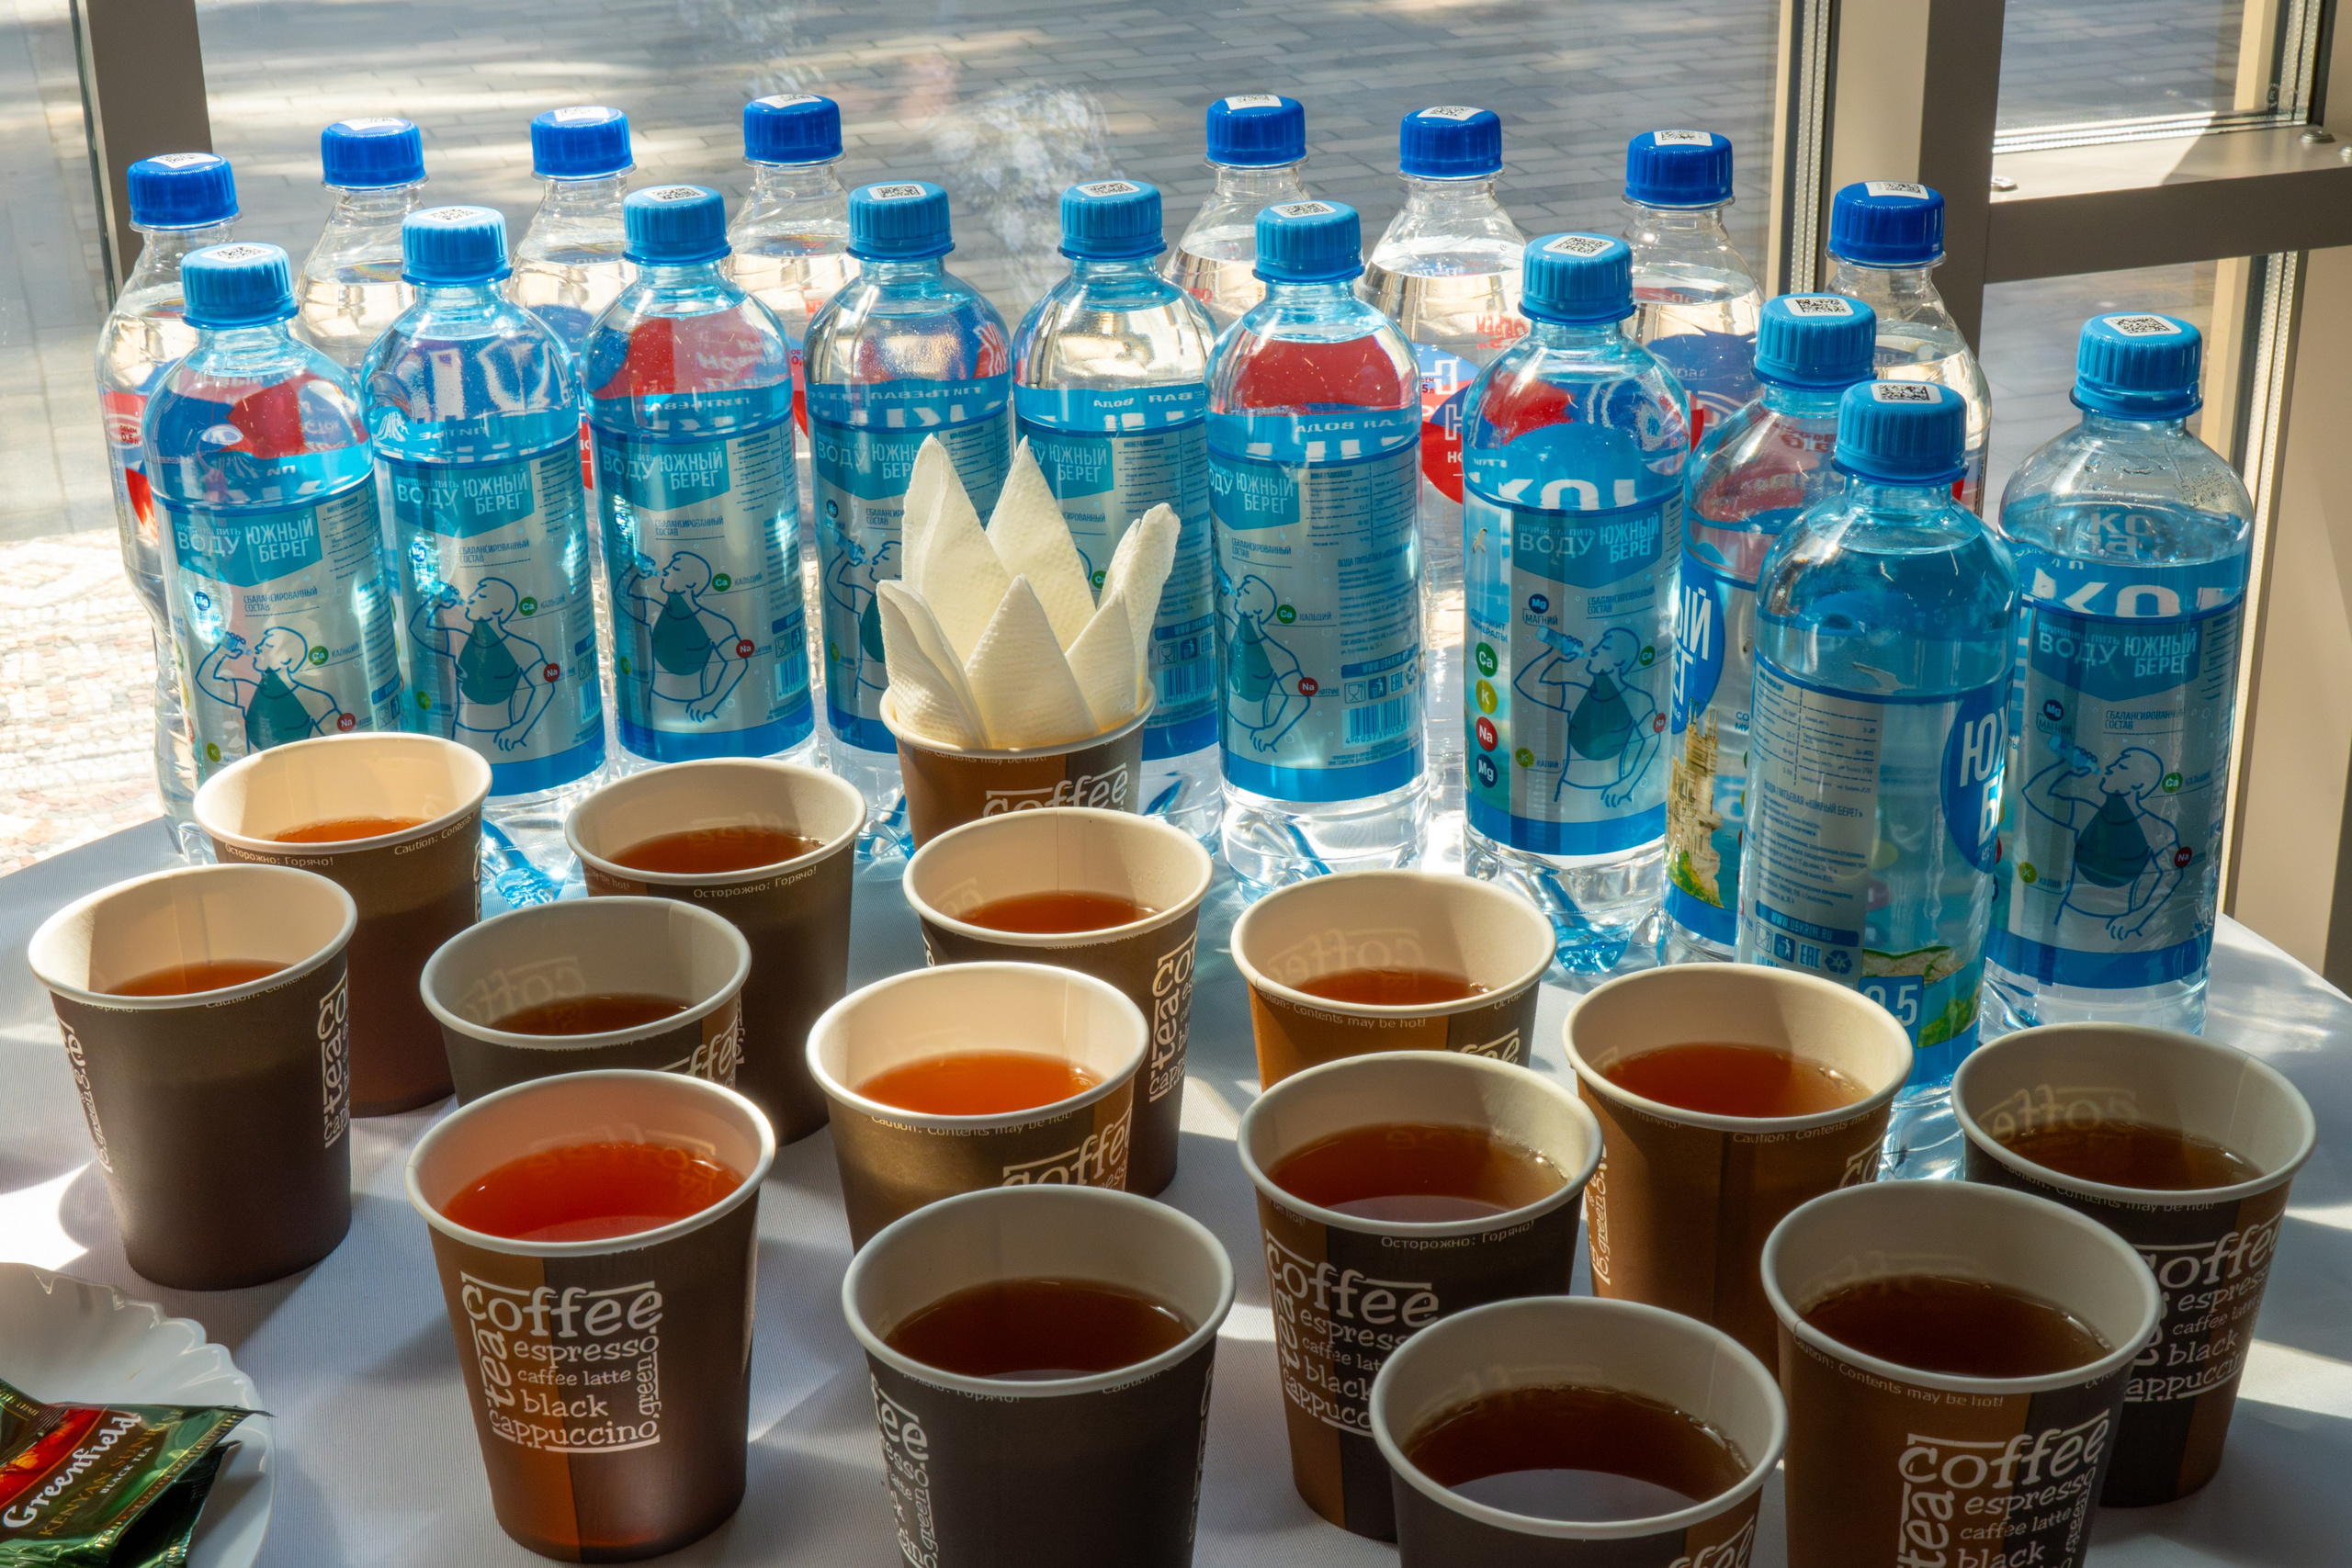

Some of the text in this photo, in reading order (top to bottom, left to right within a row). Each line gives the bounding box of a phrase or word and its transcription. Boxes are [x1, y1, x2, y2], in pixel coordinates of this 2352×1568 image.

[659, 447, 723, 472] ЮЖНЫЙ
[816, 442, 868, 468] ВОДУ
[872, 443, 919, 461] ЮЖН
[1048, 444, 1107, 466] ЮЖНЫЙ
[602, 452, 656, 480] ВОДУ
[882, 462, 911, 479] БЕР
[1057, 463, 1102, 483] БЕРЕГ
[462, 469, 528, 498] ЮЖНЫЙ
[670, 470, 718, 491] БЕРЕГ
[1209, 472, 1233, 496] ОДУ
[1236, 472, 1294, 497] ЮЖНЫЙ
[397, 484, 458, 512] ВОДУ
[475, 492, 523, 515] БЕРЕГ
[1244, 493, 1288, 514] БЕРЕГ
[245, 514, 314, 545] ЮЖНЫЙ
[655, 526, 679, 536] СОСТАВ
[1600, 512, 1659, 546] ЮЖНЫЙ
[177, 530, 241, 558] ВОДУ
[259, 539, 310, 562] БЕРЕГ
[1519, 535, 1595, 558] ВОДУ
[1610, 536, 1655, 564] БЕРЕГ
[243, 586, 318, 604] СБАЛАНСИРОВАННЫЙ
[715, 578, 729, 587] Ca
[244, 603, 271, 613] СОСТАВ
[522, 603, 535, 612] Ca
[1280, 609, 1293, 618] Ca
[1532, 597, 1547, 611] Mg
[1588, 604, 1613, 615] СОСТАВ
[1525, 614, 1558, 626] МАГНИЙ
[740, 645, 752, 653] Na
[2039, 633, 2118, 666] ВОДУ
[2124, 628, 2198, 657] ЮЖНЫЙ
[311, 651, 325, 660] Ca
[1478, 650, 1494, 670] Ca
[1643, 651, 1653, 660] Ca
[2134, 654, 2190, 678] БЕРЕГ
[547, 668, 558, 677] Na
[1302, 682, 1315, 691] Na
[341, 718, 353, 727] Na
[2047, 704, 2062, 717] Mg
[1478, 726, 1494, 743] Na
[2105, 720, 2133, 730] СОСТАВ
[1477, 762, 1494, 783] Mg
[225, 842, 334, 867] Осторожно: Горячо!
[394, 835, 438, 856] Caution:
[2177, 853, 2189, 862] Na
[693, 866, 818, 898] Осторожно: Горячо!
[1293, 1002, 1426, 1030] Contents may be hot!
[1733, 1131, 1792, 1144] Caution:
[1795, 1121, 1849, 1140] Contents
[1381, 1220, 1534, 1251] Осторожно: Горячо!
[1267, 1243, 1439, 1328] coffee
[461, 1284, 663, 1338] coffee
[1300, 1309, 1408, 1351] espress
[514, 1335, 660, 1370] espresso
[1302, 1337, 1351, 1366] caffee
[2166, 1329, 2240, 1367] black
[478, 1331, 516, 1408] tea
[517, 1368, 632, 1386] caffee latte
[1304, 1356, 1371, 1402] black
[636, 1355, 662, 1417] green
[1839, 1362, 1902, 1394] Contents
[1907, 1388, 1941, 1404] may
[1946, 1393, 1967, 1404] be
[1972, 1395, 2004, 1407] hot!
[520, 1389, 610, 1418] black
[1283, 1369, 1371, 1429] cappucc
[489, 1408, 659, 1450] cappuccino
[1898, 1418, 2109, 1490] coffee
[3, 1412, 142, 1529] Greenfield
[99, 1446, 154, 1495] BLACK TEA
[39, 1471, 113, 1536] KENYAN
[1964, 1466, 2097, 1521] espresso
[1897, 1490, 1955, 1568] tea
[1960, 1506, 2072, 1540] caffee latte
[1958, 1540, 2046, 1568] black
